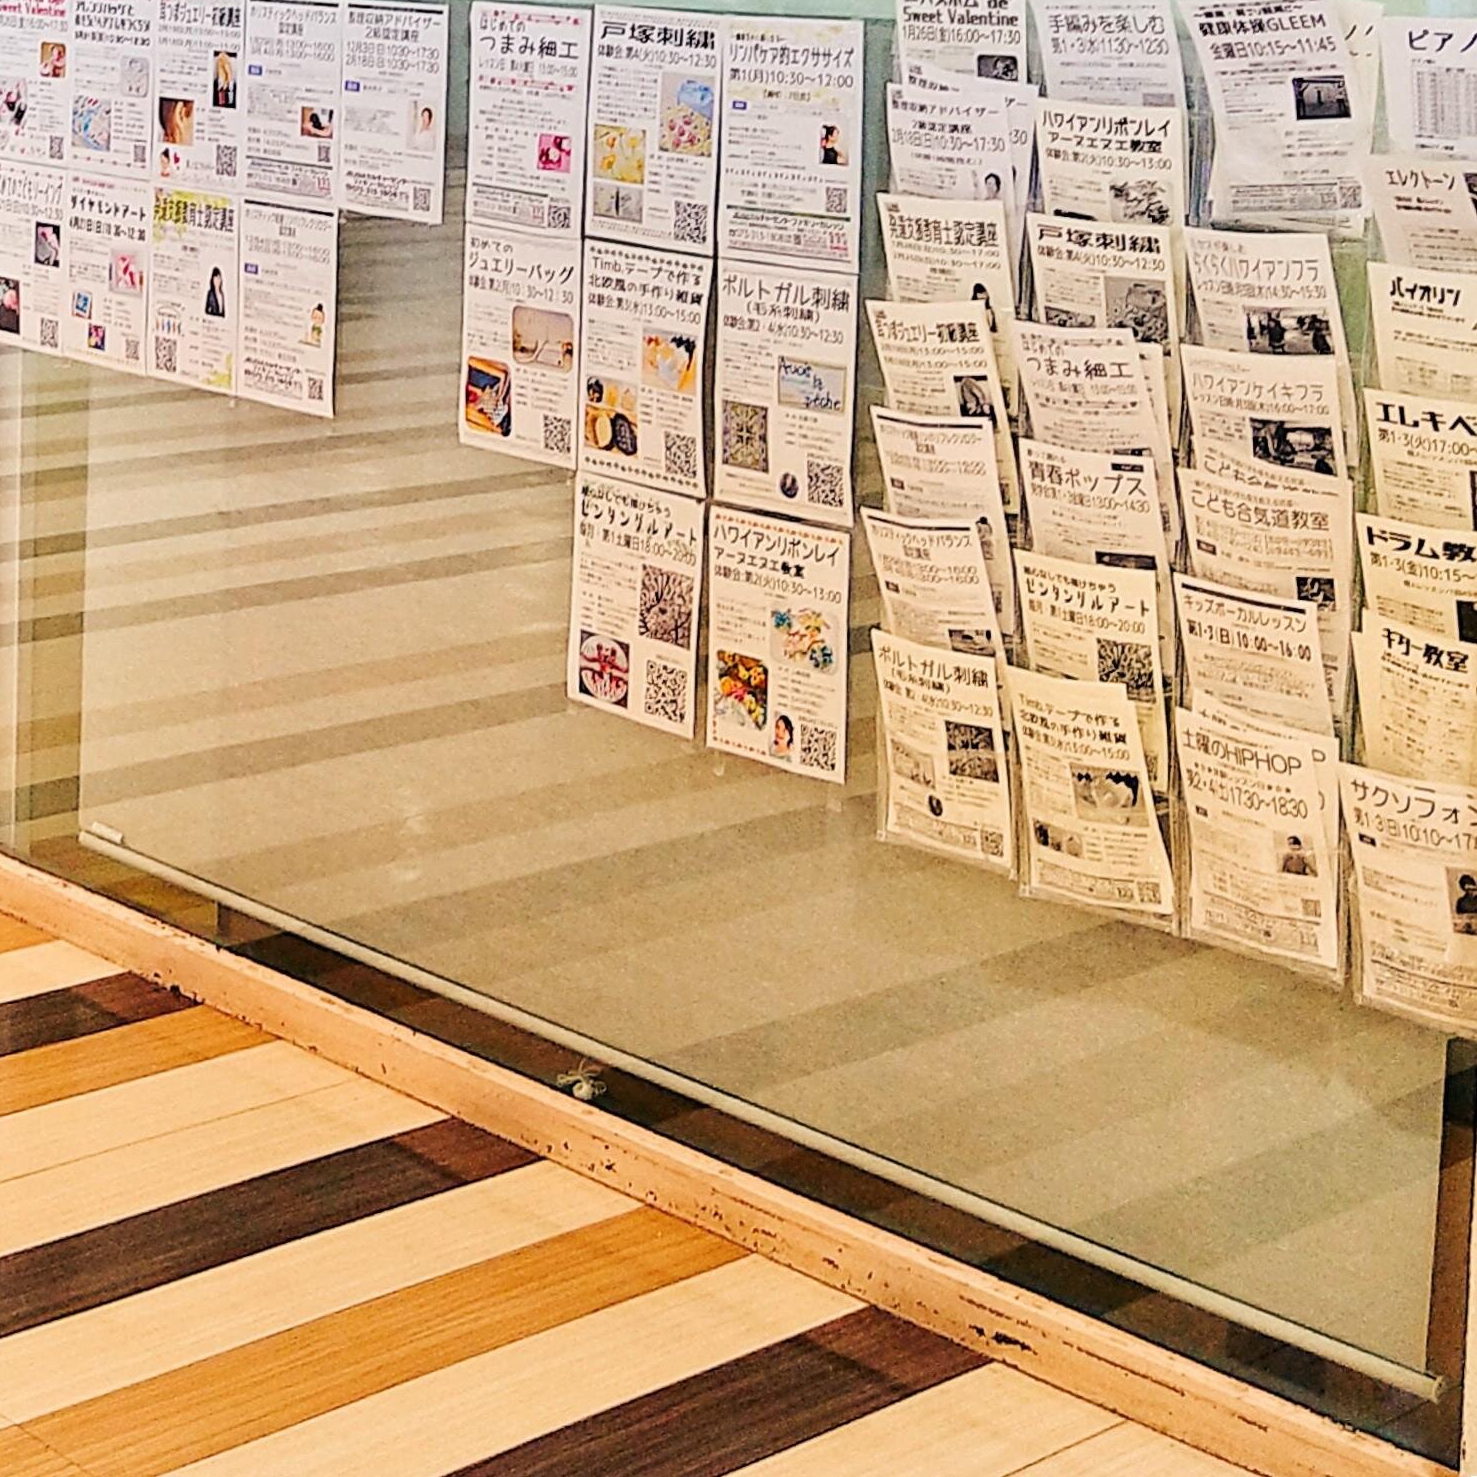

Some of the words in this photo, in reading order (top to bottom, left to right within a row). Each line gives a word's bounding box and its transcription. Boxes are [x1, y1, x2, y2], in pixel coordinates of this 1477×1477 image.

[25, 1, 66, 17] Valentine
[903, 8, 944, 25] Sweet
[947, 9, 1019, 27] Valentine
[1049, 14, 1165, 35] 手編みを楽しむ
[478, 34, 580, 61] つまみ細工
[600, 19, 717, 51] 戸塚刺繍
[1408, 28, 1477, 54] ピアノ
[728, 42, 855, 69] リンパケア的エクササイズ
[1042, 110, 1172, 138] ハワイアンリボンレイ
[1047, 131, 1164, 155] アーヌエヌエ教室
[1386, 168, 1457, 191] エレクトーン
[70, 195, 147, 222] ダイヤモンドアート
[1037, 224, 1161, 255] 戸塚刺繍
[468, 251, 575, 284] ジュエリーバッグ
[1193, 251, 1320, 282] らくらくハワイアンフラ
[722, 274, 851, 312] ポルトガル刺繍
[1390, 276, 1462, 308] バイオリン
[1026, 356, 1136, 380] つまみ細工
[1192, 373, 1325, 403] ハワイアンケイキフラ
[1027, 460, 1148, 497] 青春ポップス
[581, 498, 698, 548] ゼンタングルアート
[1191, 488, 1331, 532] こども合気道教室
[714, 524, 841, 566] ハワイアンリボンレイ
[714, 545, 806, 579] アーヌエヌエ教室
[1025, 578, 1150, 618] ゼンタングルアート
[878, 645, 990, 690] ポルトガル刺繍
[1182, 726, 1303, 777] 土曜のHIPHOP
